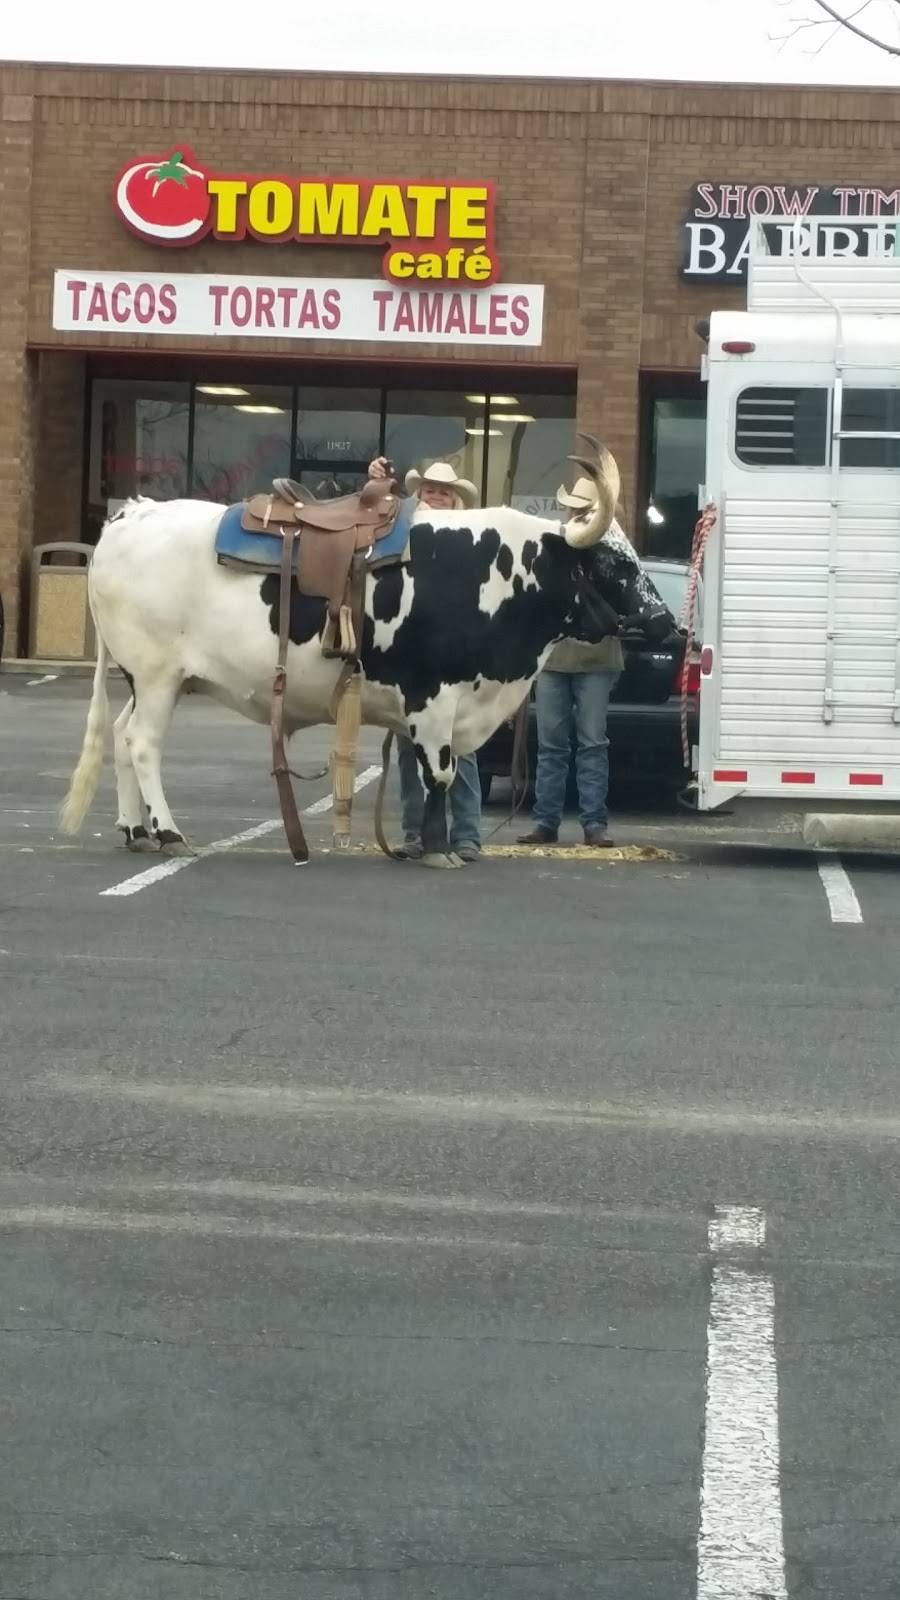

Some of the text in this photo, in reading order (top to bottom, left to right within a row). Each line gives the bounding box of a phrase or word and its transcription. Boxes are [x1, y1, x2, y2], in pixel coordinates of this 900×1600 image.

[208, 180, 487, 239] TOMATE
[694, 183, 820, 219] SHOW
[388, 246, 493, 281] café
[67, 280, 531, 337] TACOS TORTAS TAMALES
